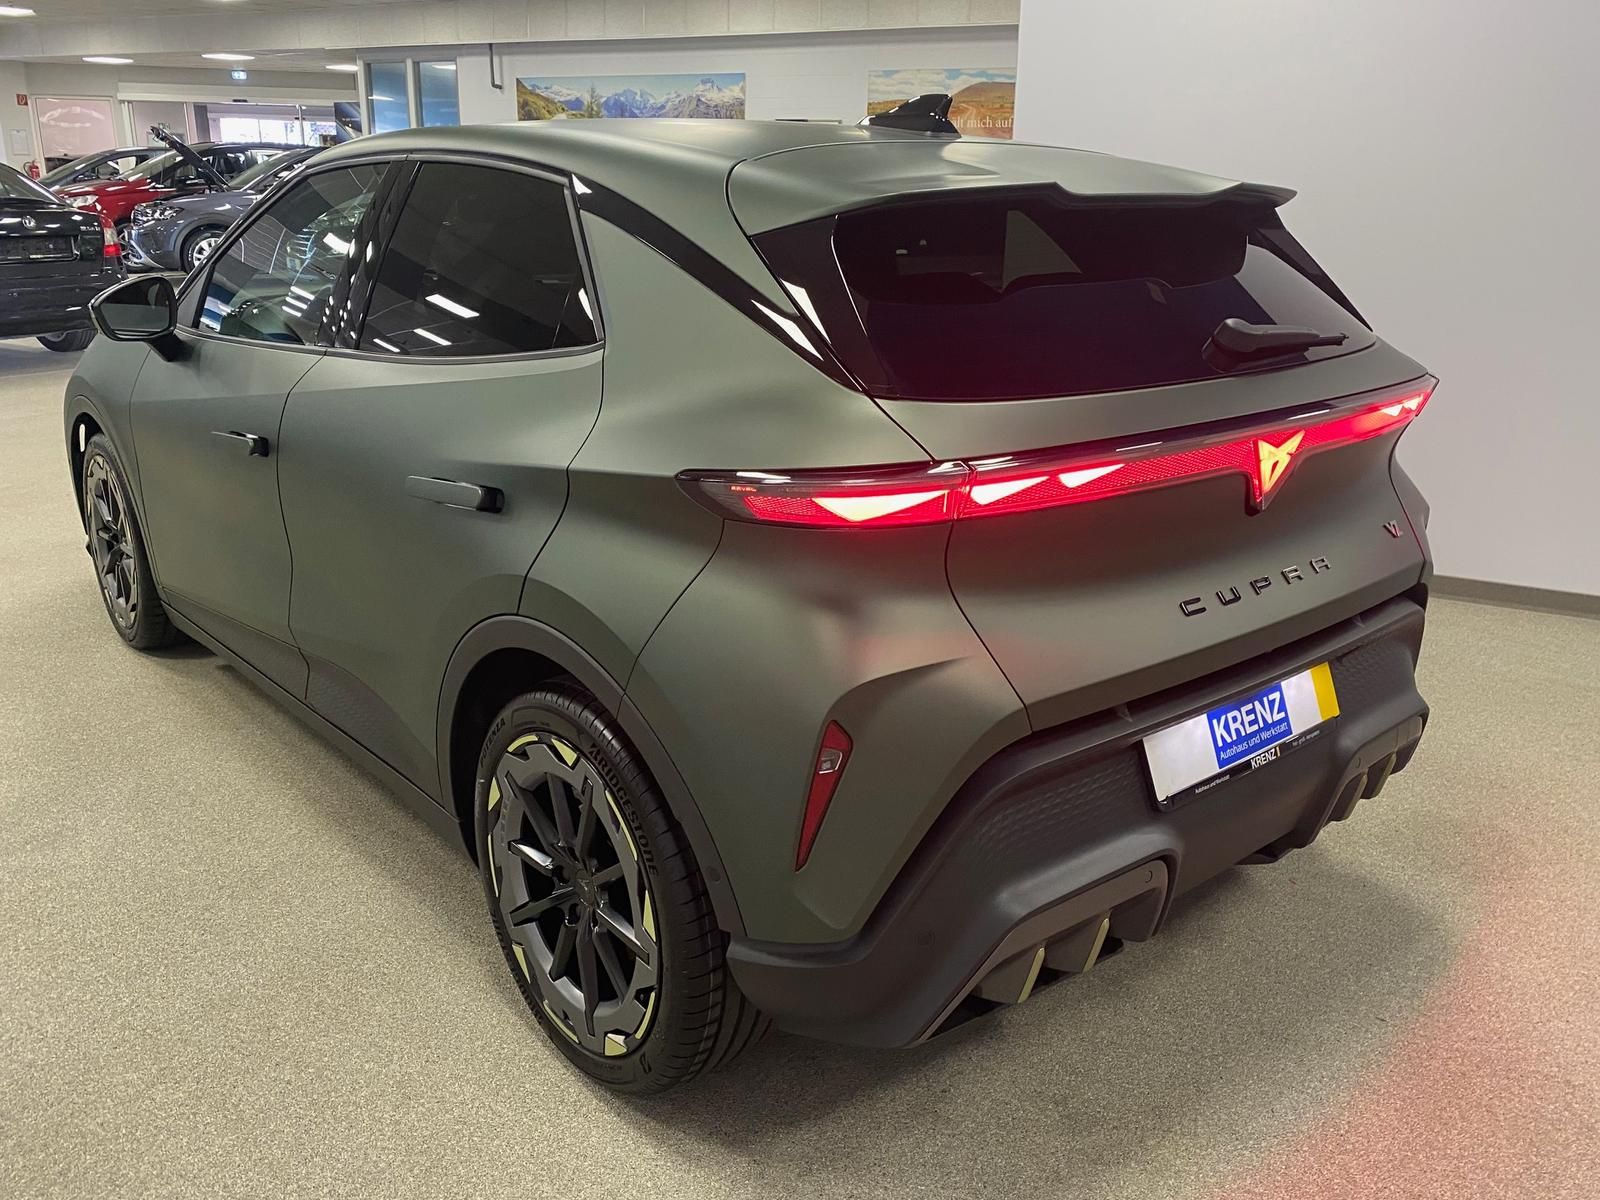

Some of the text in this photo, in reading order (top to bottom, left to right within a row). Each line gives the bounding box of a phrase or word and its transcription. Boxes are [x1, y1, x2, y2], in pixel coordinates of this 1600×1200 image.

[966, 116, 993, 128] mich
[995, 116, 1013, 128] auf
[1179, 556, 1332, 617] CUPRA
[1212, 691, 1286, 747] KRENZ
[1220, 740, 1248, 760] Autohaus
[1248, 736, 1260, 746] und
[1260, 722, 1289, 742] Werkstatt
[1250, 748, 1277, 769] KRENZ
